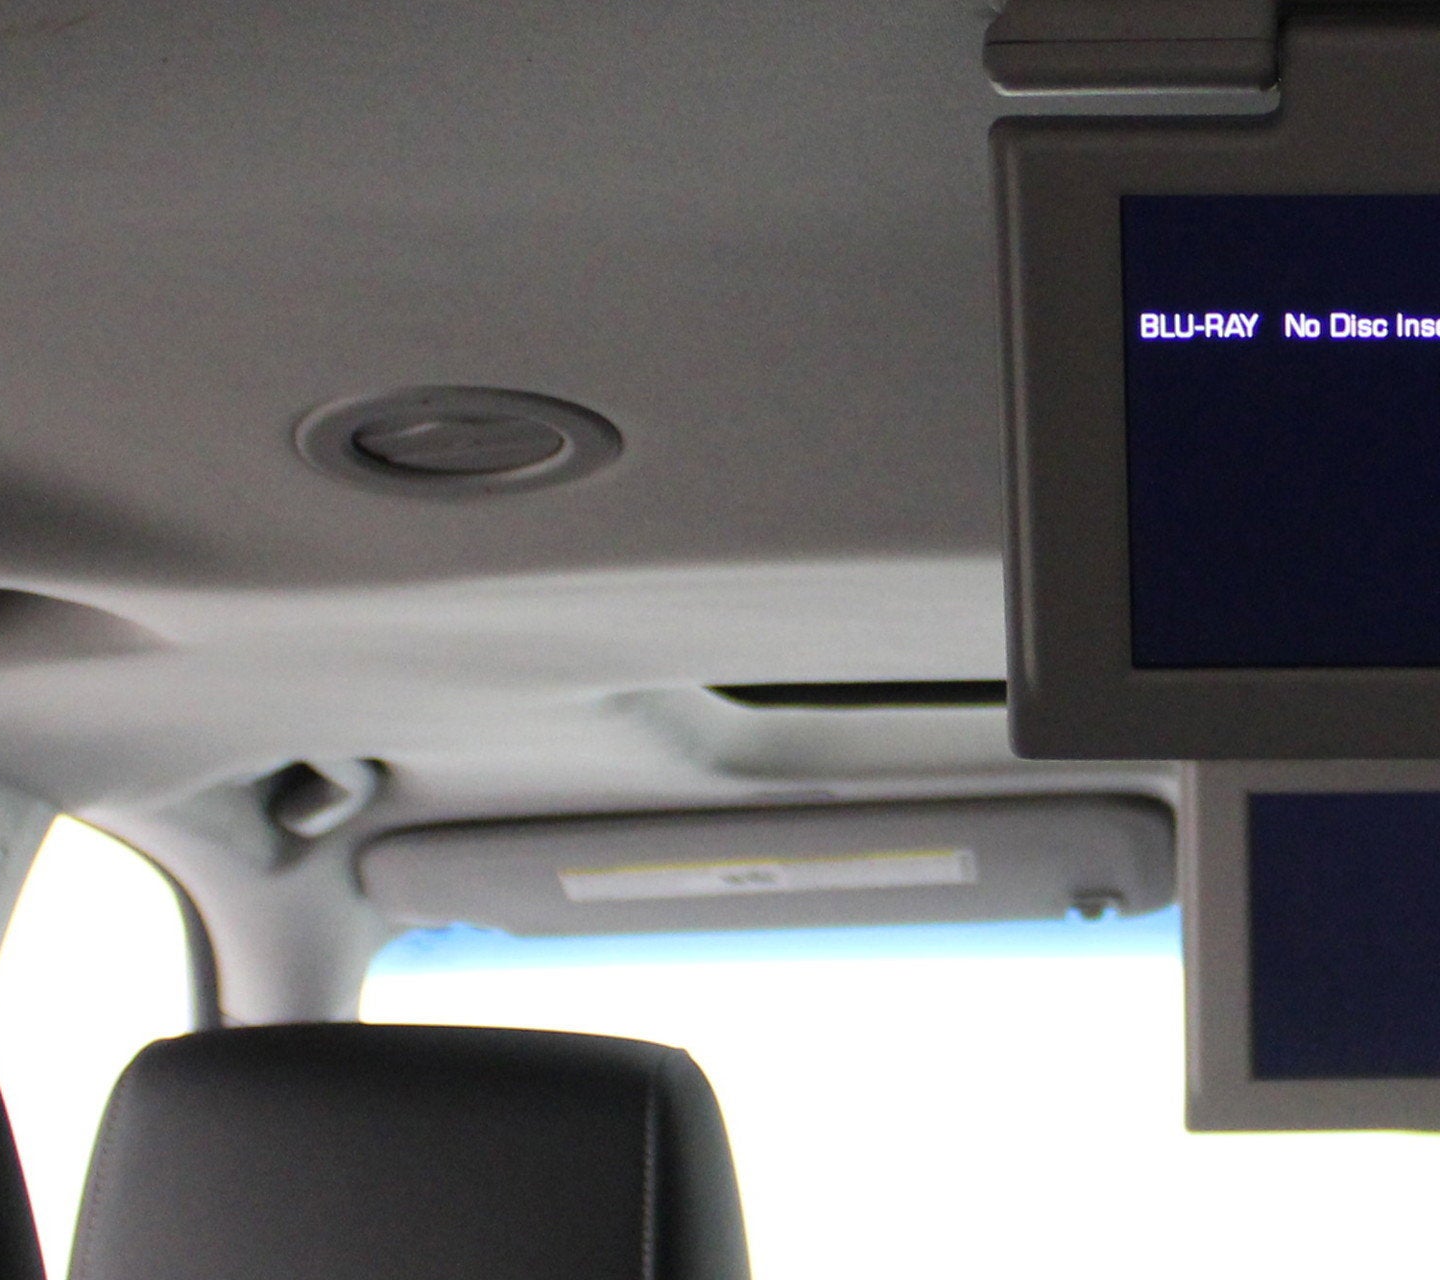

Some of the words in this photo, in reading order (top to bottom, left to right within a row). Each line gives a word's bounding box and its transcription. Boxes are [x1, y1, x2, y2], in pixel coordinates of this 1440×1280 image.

[1139, 311, 1260, 340] BLU-RAY
[1284, 311, 1321, 339] No
[1328, 311, 1390, 339] Disc
